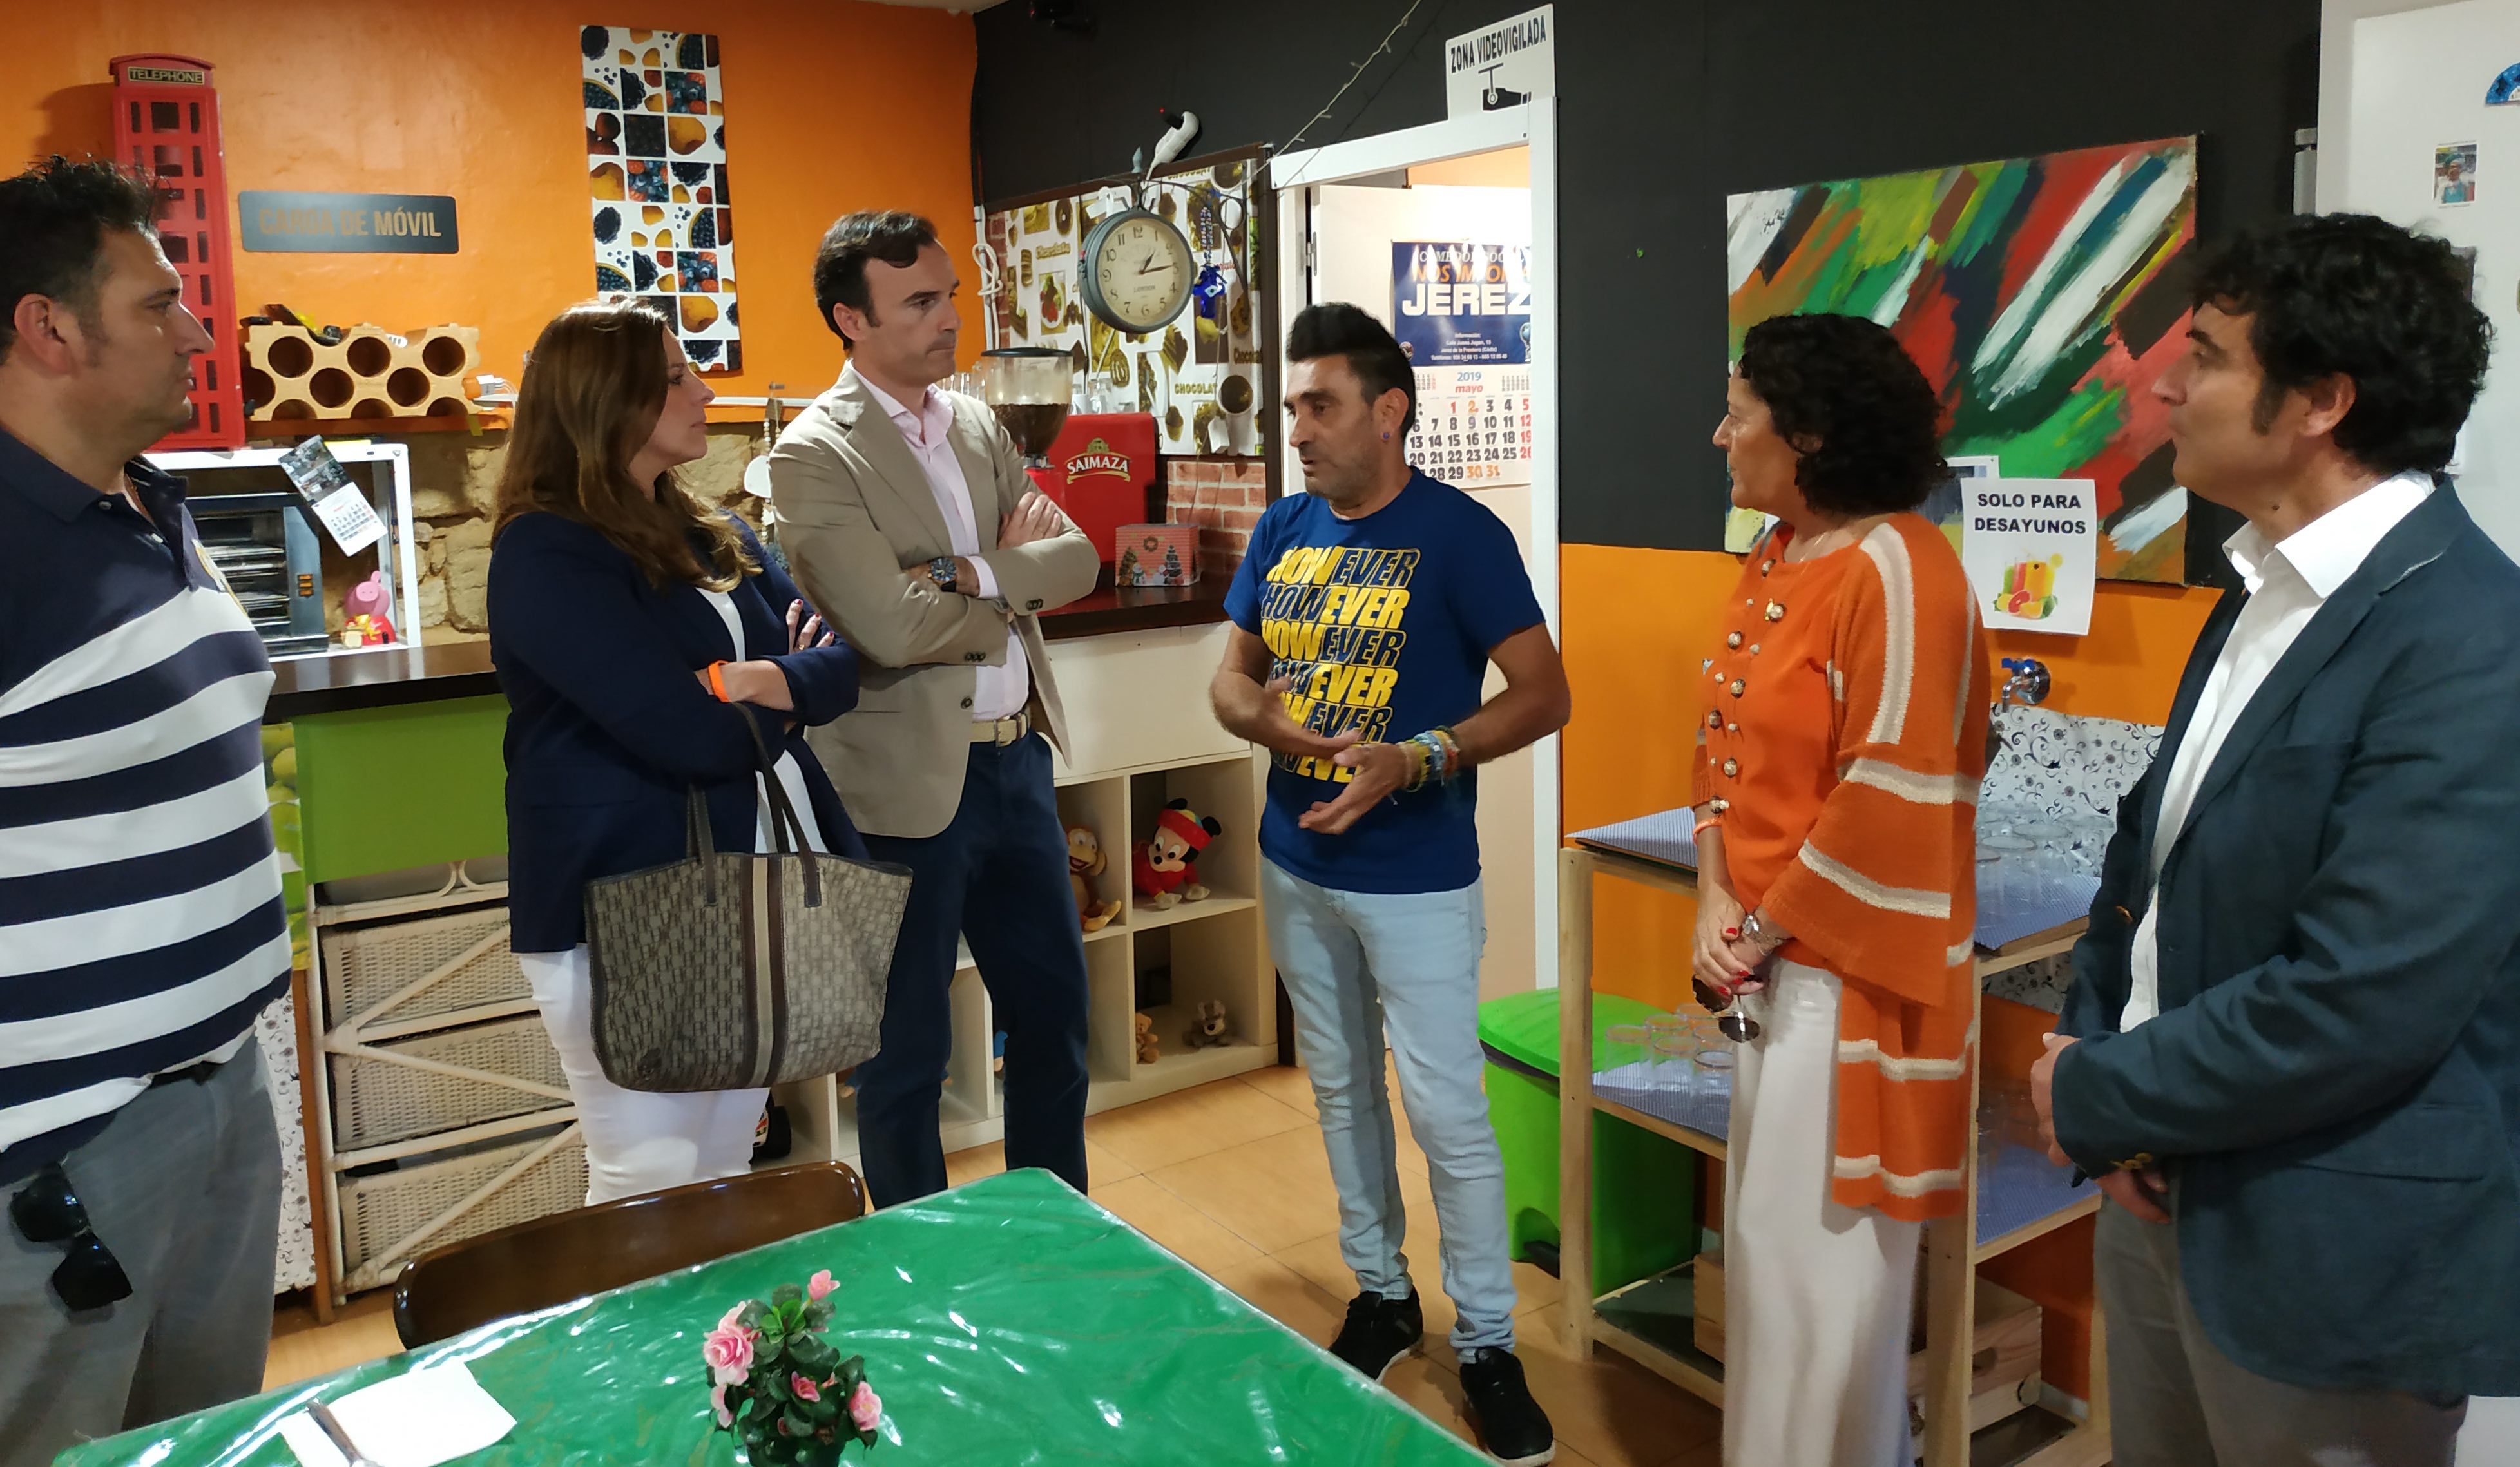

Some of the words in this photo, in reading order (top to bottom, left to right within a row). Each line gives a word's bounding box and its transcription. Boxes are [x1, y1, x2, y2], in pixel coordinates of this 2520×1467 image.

[1450, 41, 1475, 73] ZONA
[1477, 15, 1546, 64] VIDEOVIGILADA
[131, 69, 203, 82] TELEPHONE
[340, 209, 369, 236] DE
[374, 206, 442, 238] MÓVIL
[1117, 233, 1125, 246] 11
[1133, 226, 1144, 239] 12
[1106, 248, 1117, 262] 10
[1102, 269, 1112, 282] 9
[1123, 301, 1131, 314] 7
[1402, 283, 1532, 316] JEREZ
[1457, 372, 1482, 382] 2019
[1455, 385, 1483, 394] mayo
[1450, 401, 1456, 414] 1
[1468, 400, 1476, 413] 2
[1486, 399, 1494, 412] 3
[1504, 398, 1512, 411] 4
[1523, 398, 1529, 411] 5
[1412, 419, 1421, 432] 6
[1431, 418, 1439, 431] 7
[1450, 417, 1457, 430] 8
[1468, 416, 1476, 429] 9
[1484, 416, 1497, 428] 10
[1503, 416, 1514, 428] 11
[1520, 414, 1532, 427] 12
[1410, 436, 1423, 449] 13
[1428, 434, 1443, 448] 14
[1448, 434, 1461, 446] 15
[1466, 432, 1479, 446] 16
[1485, 432, 1497, 445] 17
[1502, 430, 1515, 444] 18
[1520, 430, 1532, 443] 19
[1409, 452, 1425, 466] 20
[1430, 451, 1443, 465] 21
[1448, 450, 1463, 463] 22
[1466, 449, 1481, 462] 23
[1484, 448, 1499, 461] 24
[1502, 447, 1517, 460] 25
[1067, 455, 1128, 475] SAIMAZA
[1429, 467, 1445, 481] 28
[1448, 466, 1464, 480] 29
[1467, 465, 1483, 478] 30
[1486, 465, 1499, 477] 31
[1977, 494, 2025, 507] SOLO
[2031, 495, 2081, 509] PARA
[1974, 517, 2086, 534] DESAYUNOS
[1260, 582, 1410, 629] HOWEVER
